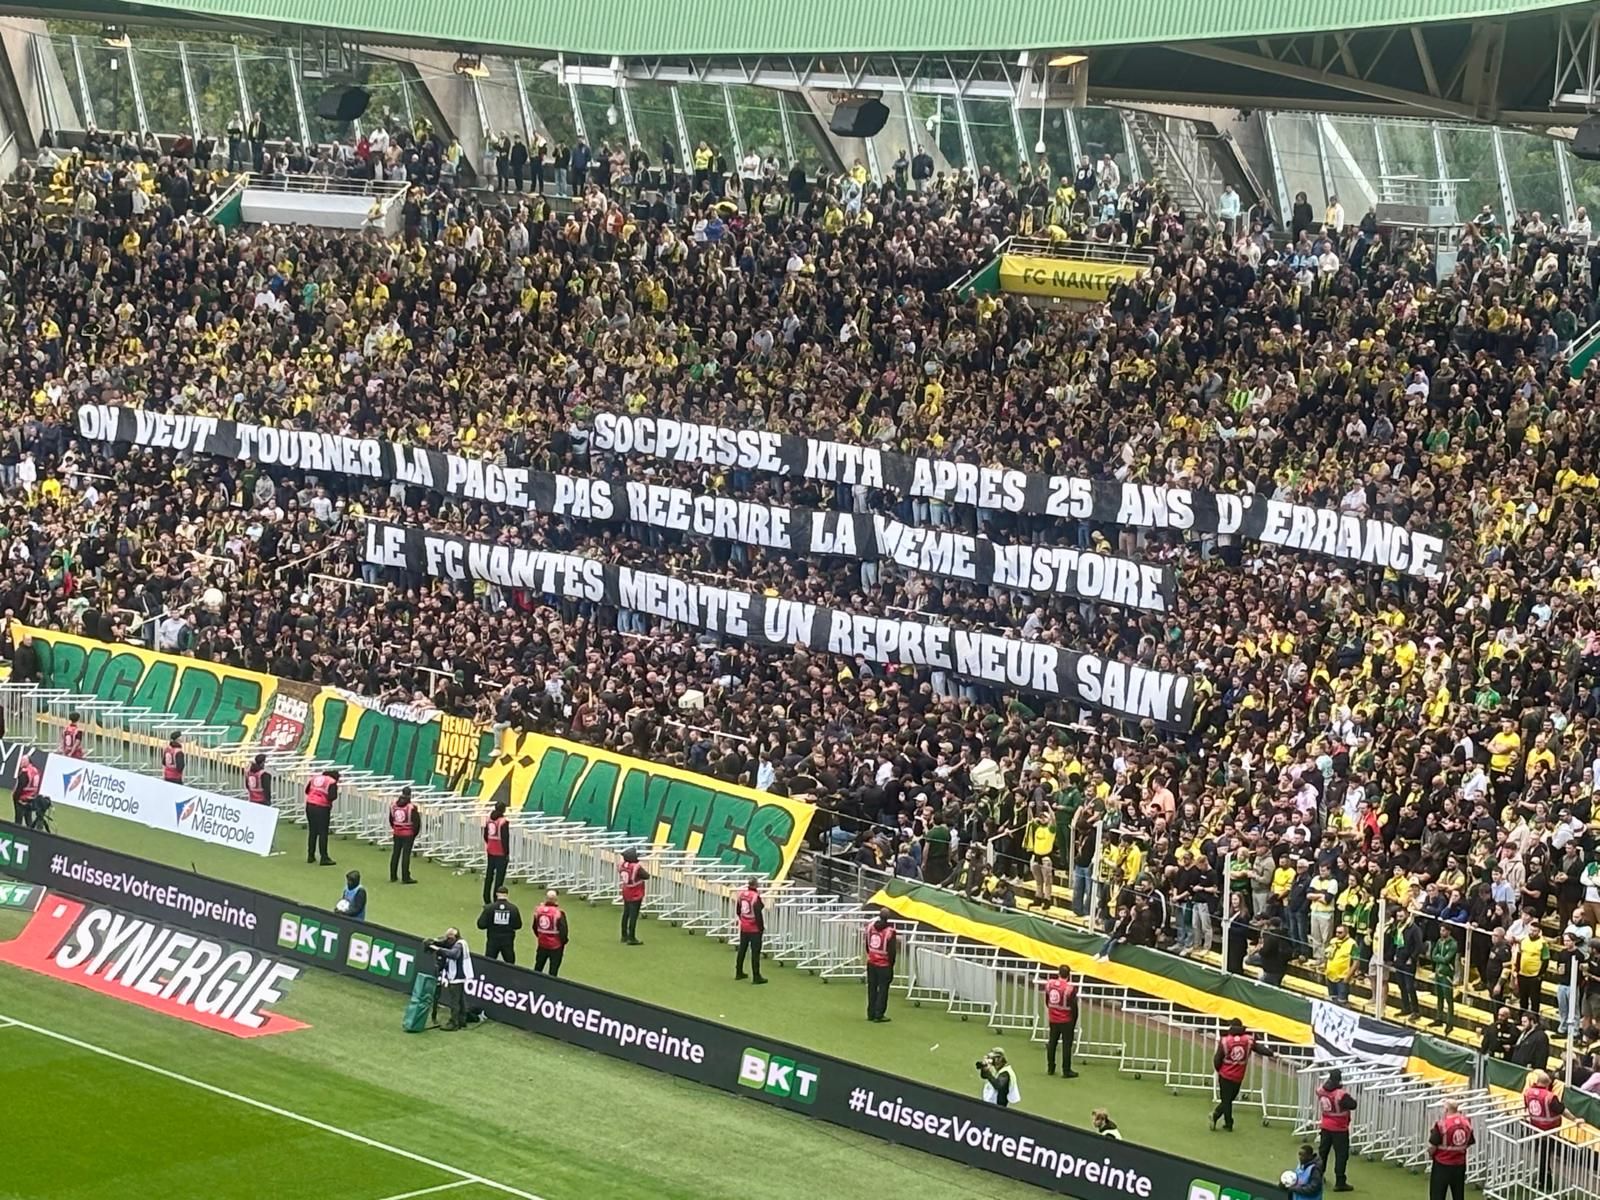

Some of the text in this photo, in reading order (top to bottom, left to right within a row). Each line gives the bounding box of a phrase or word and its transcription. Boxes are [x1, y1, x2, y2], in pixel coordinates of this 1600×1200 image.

[1023, 268, 1116, 290] FC NANTE
[594, 413, 790, 475] SOCPRESSE,
[910, 457, 1027, 512] APRES
[1046, 475, 1094, 518] 25
[1116, 483, 1196, 529] ANS
[1215, 493, 1253, 534] D'
[78, 404, 120, 441] ON
[135, 410, 218, 453] VEUT
[235, 423, 383, 478] TOURNER
[394, 443, 434, 488] LA
[552, 474, 614, 520] PAS
[626, 481, 792, 549] REECRIRE
[810, 512, 857, 556] LA
[873, 514, 976, 580] MEME
[365, 523, 407, 568] LE
[424, 536, 465, 581] FC
[468, 542, 605, 602] NANTES
[618, 566, 750, 637] MERITE
[763, 597, 817, 648] UN
[1077, 654, 1190, 723] SAIN!
[438, 732, 480, 761] NOUS
[435, 754, 449, 776] LE
[82, 768, 126, 793] Nantes
[79, 785, 140, 815] Métropole
[195, 797, 241, 823] Nantes
[191, 814, 255, 844] Métropole
[521, 746, 796, 885] NANTES
[56, 909, 301, 1028] SYNERGIE
[50, 854, 257, 930] #LaissezVotreEmpreinte
[279, 918, 338, 954] BKT
[349, 938, 414, 977] BKT
[740, 1054, 818, 1097] BKT
[848, 1088, 1152, 1198] #LaissezVotreEmpreinte
